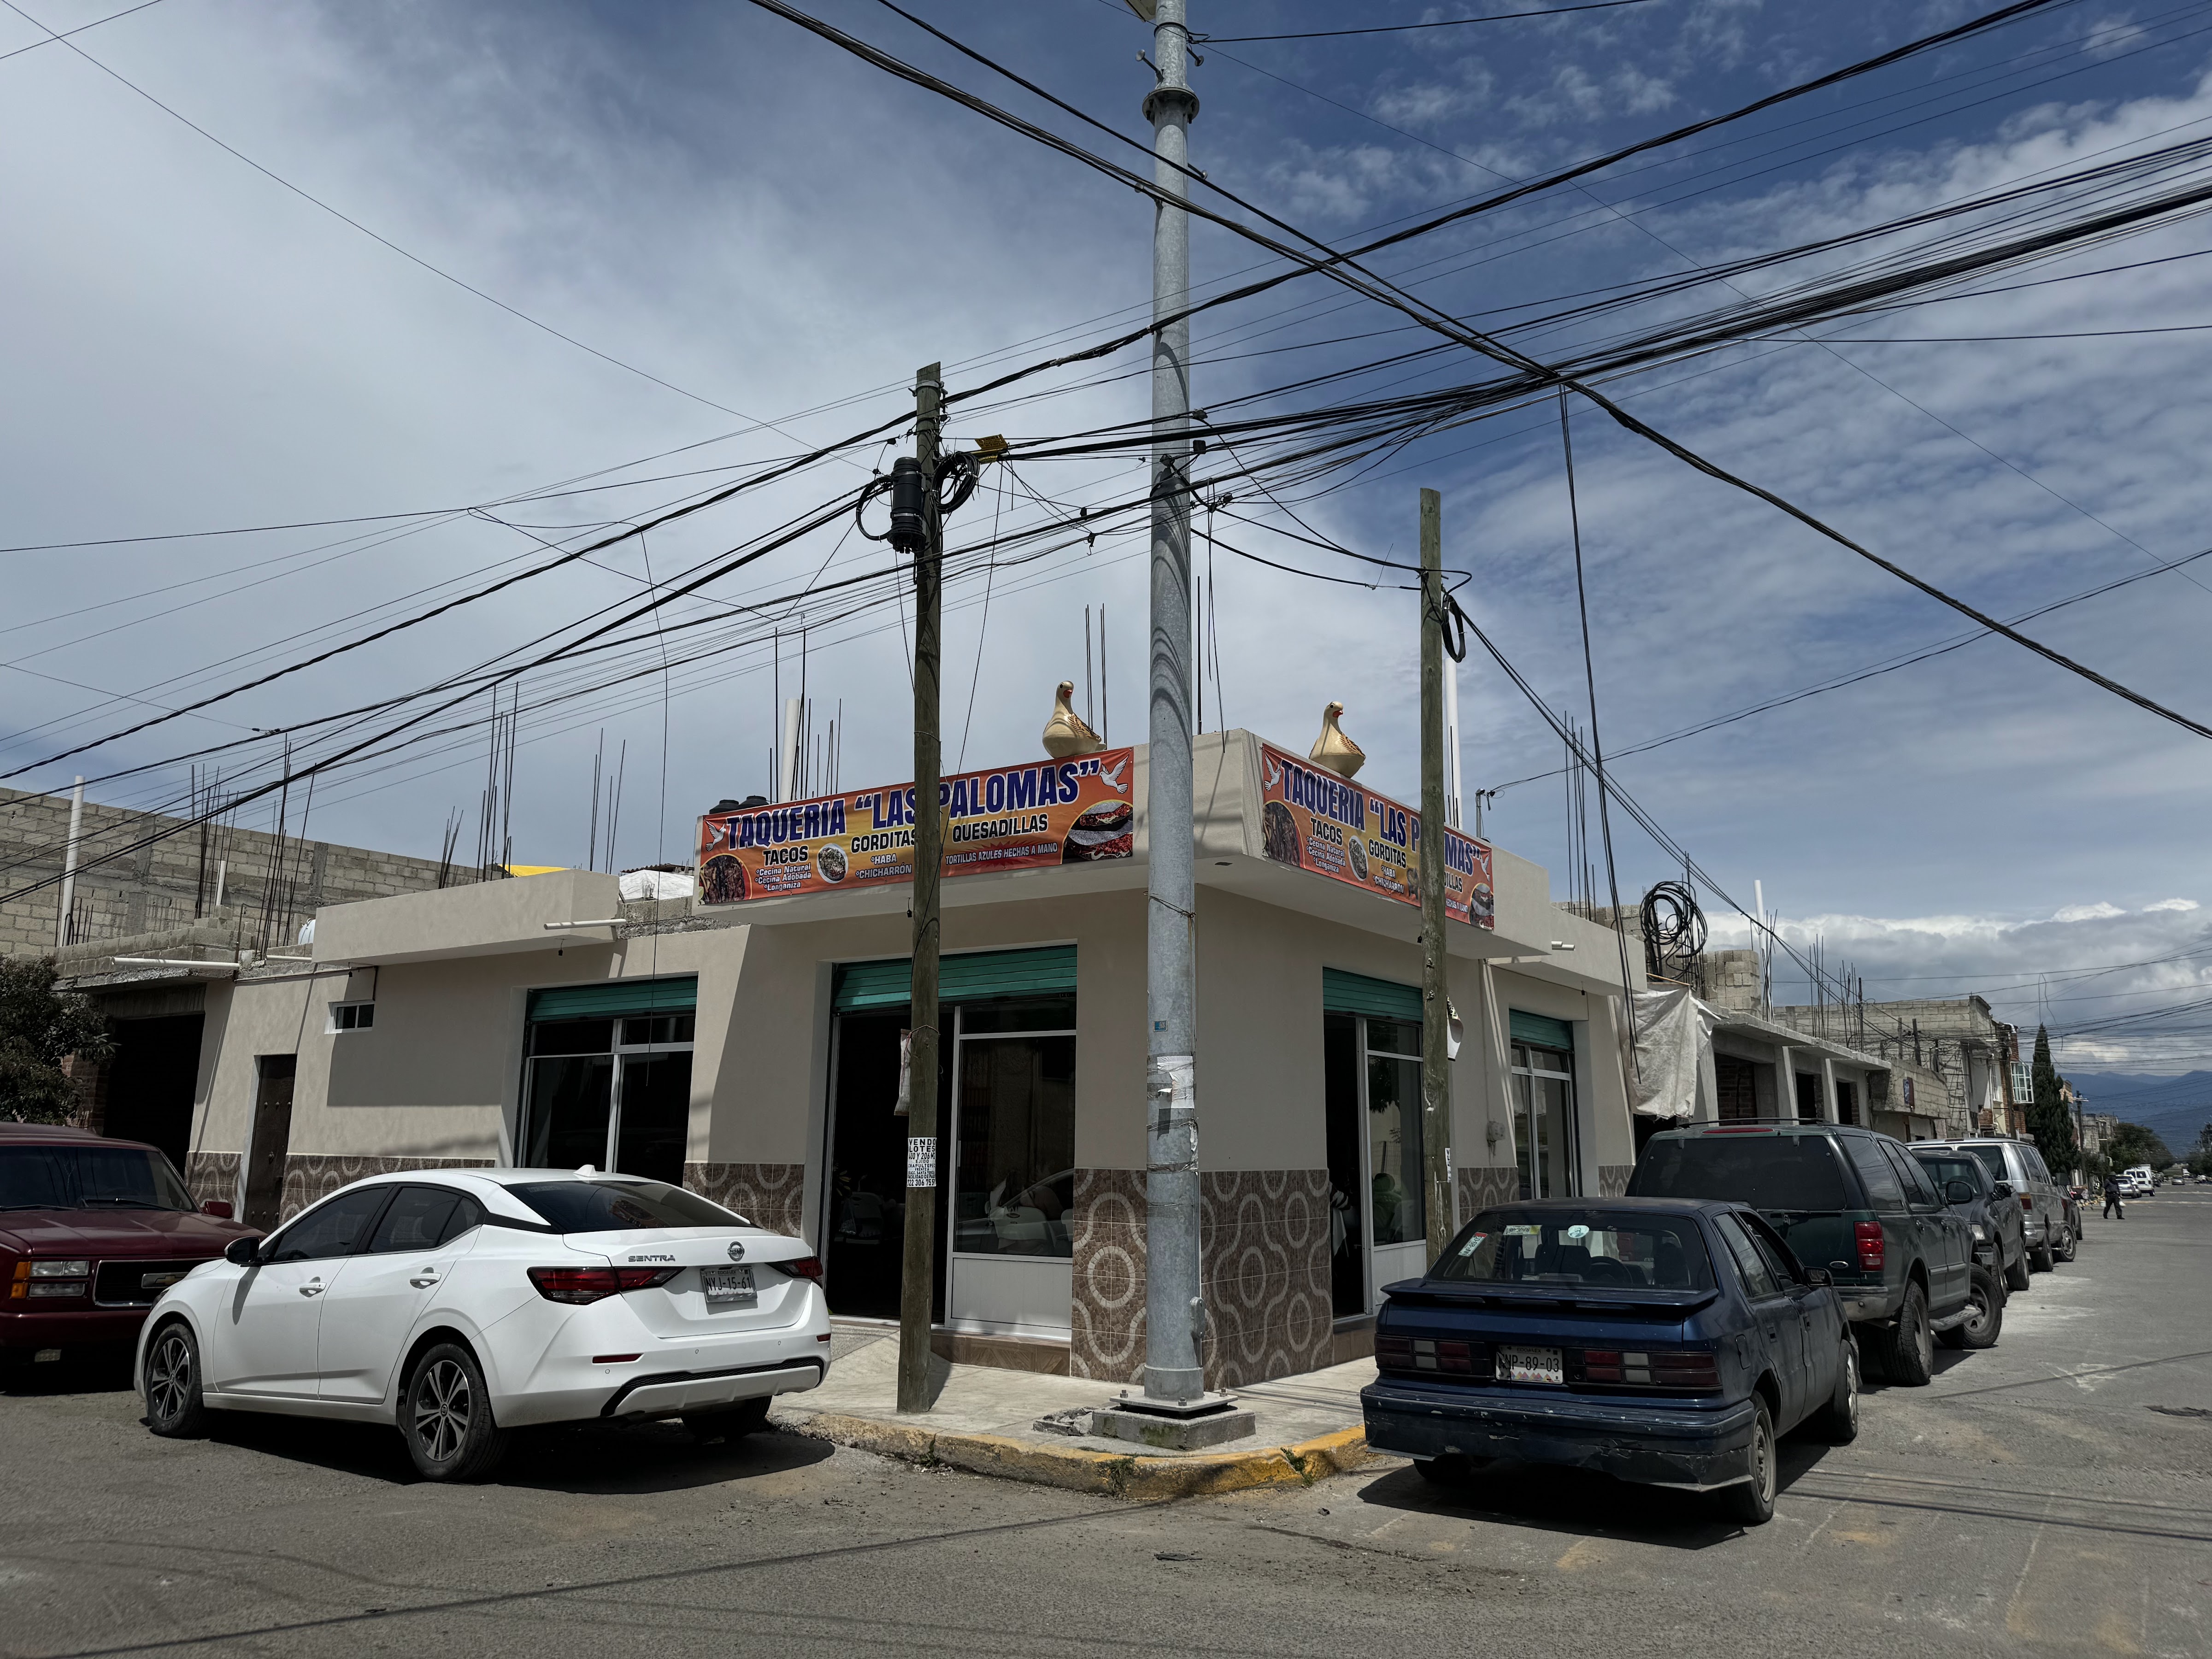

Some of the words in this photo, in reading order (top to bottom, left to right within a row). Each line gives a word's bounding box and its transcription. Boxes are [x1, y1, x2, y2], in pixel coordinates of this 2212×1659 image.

[1281, 759, 1366, 832] TAQUERIA
[727, 799, 846, 850] TAQUERIA
[952, 813, 1048, 843] QUESADILLAS
[1310, 816, 1343, 847] TACOS
[763, 845, 808, 866] TACOS
[945, 852, 977, 865] TORTILLAS
[978, 849, 1002, 861] AZULES
[1003, 846, 1030, 858] HECHAS
[1031, 845, 1035, 855] A
[1038, 842, 1058, 854] MANO
[1326, 853, 1346, 866] Adobada
[1327, 843, 1345, 857] Natural
[1368, 838, 1407, 869] GORDITAS
[782, 872, 811, 882] Adobada
[784, 862, 811, 873] Natural
[706, 1277, 752, 1291] NYJ-15-61
[1499, 1353, 1559, 1372] NP-89-03
